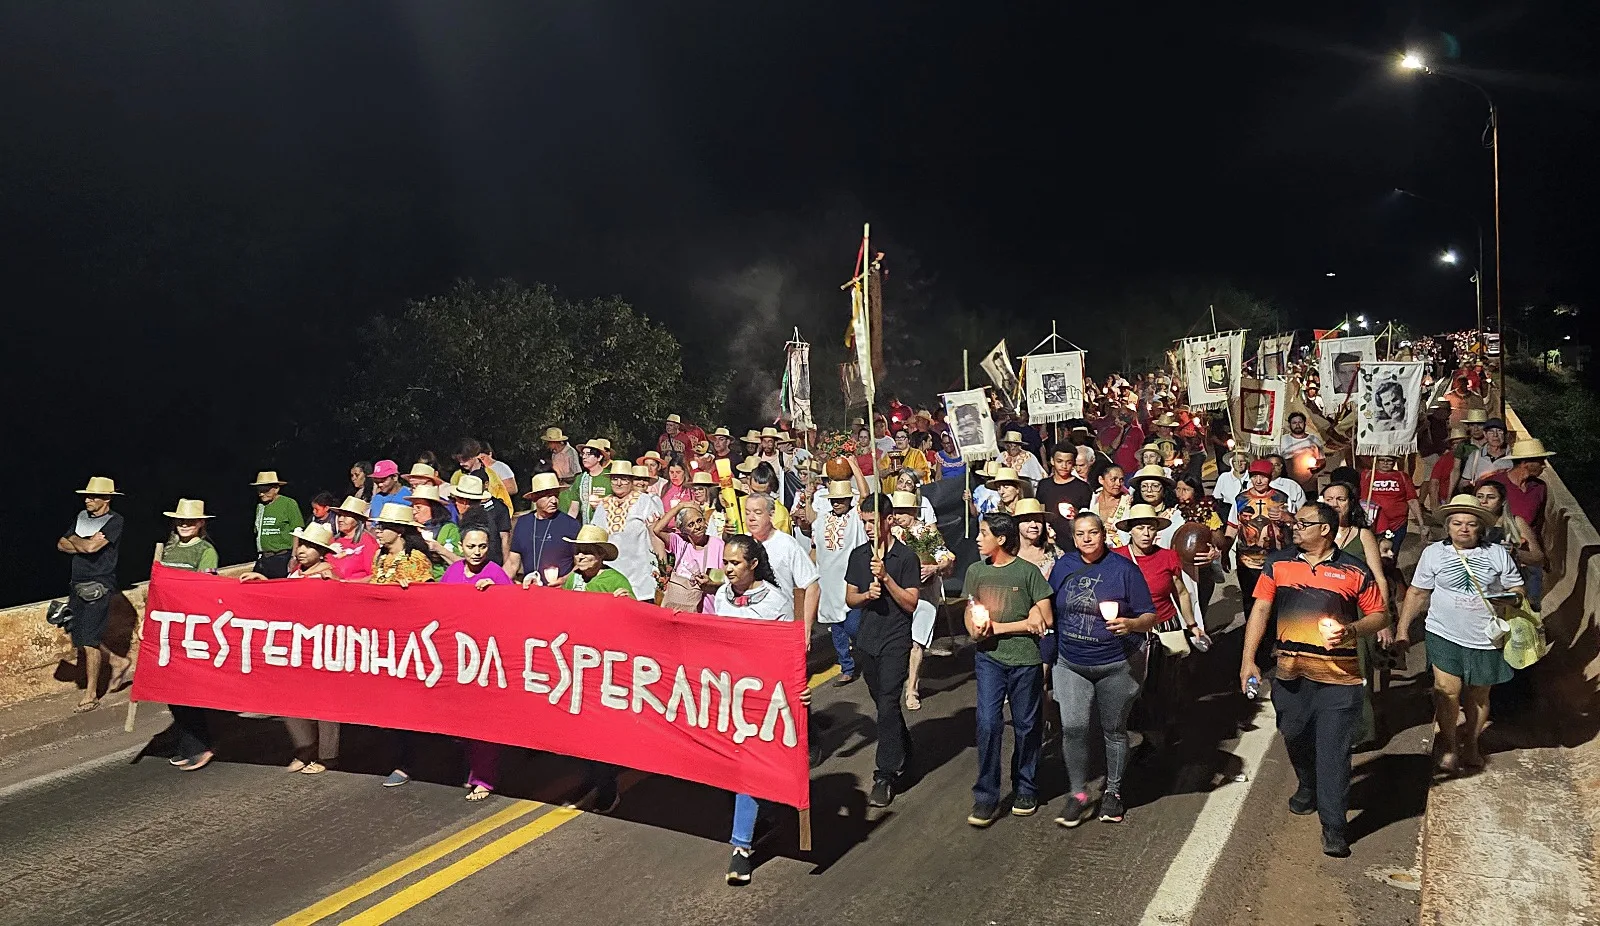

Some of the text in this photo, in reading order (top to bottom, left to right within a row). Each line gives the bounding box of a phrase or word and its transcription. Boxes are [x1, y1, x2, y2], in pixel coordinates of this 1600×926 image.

[149, 609, 798, 748] TESTEMUNHAS DA ESPERANÇA
